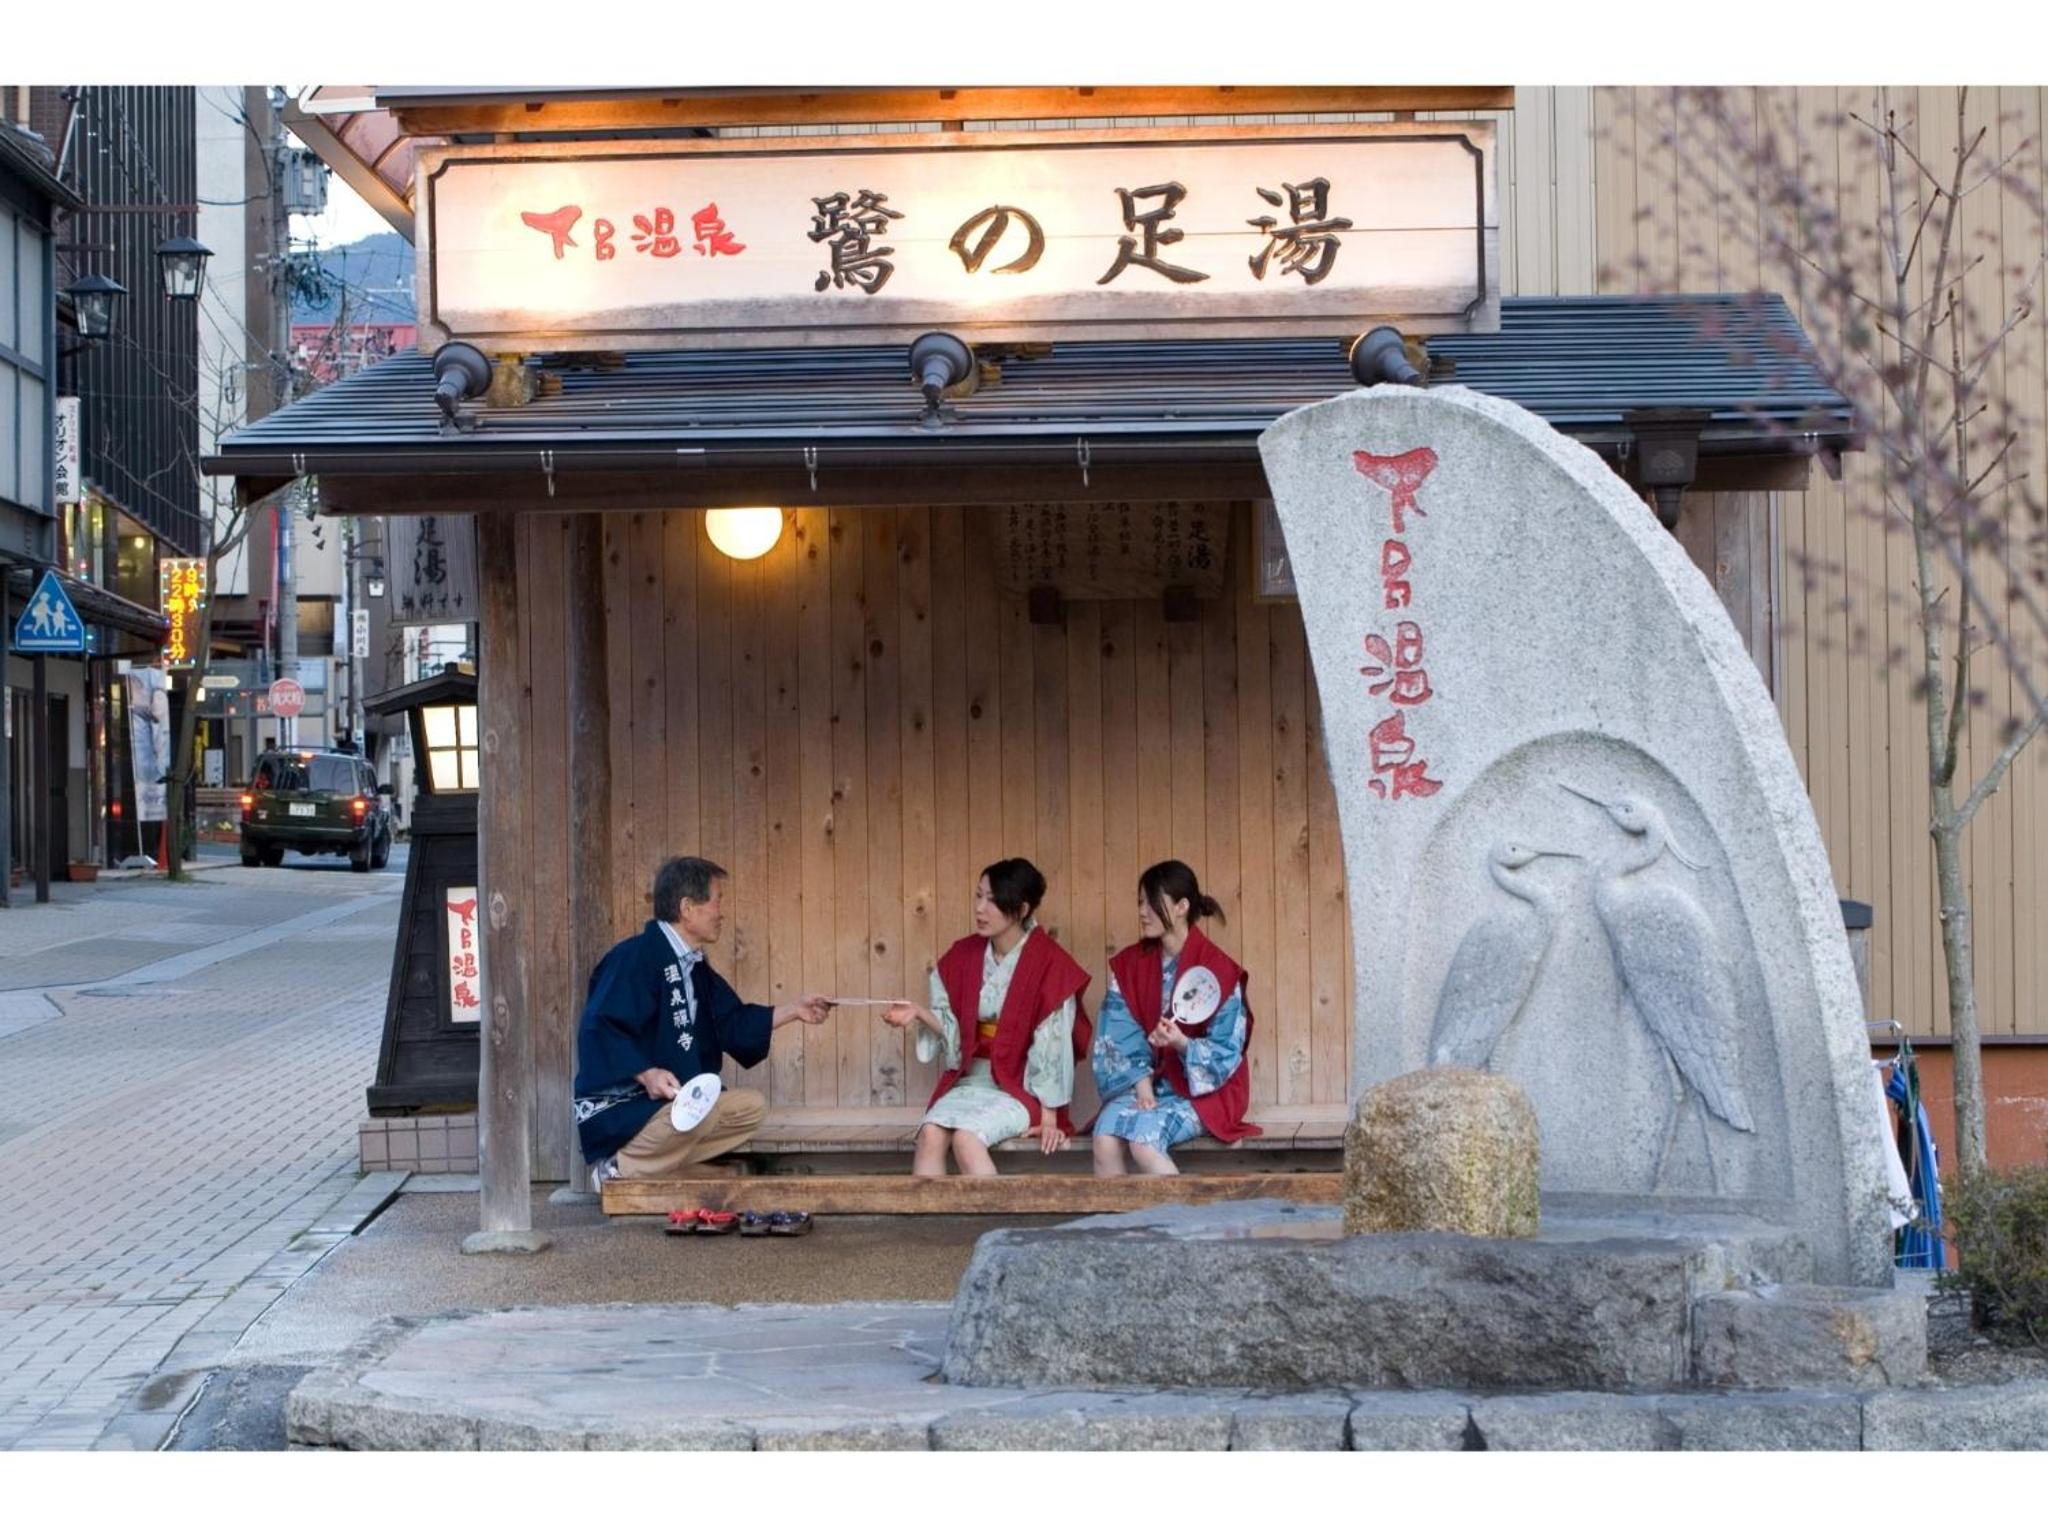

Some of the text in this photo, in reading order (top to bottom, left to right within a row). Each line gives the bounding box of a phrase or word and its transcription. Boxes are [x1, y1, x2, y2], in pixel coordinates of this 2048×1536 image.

[521, 176, 1354, 295] 下呂温泉 鷺の足湯
[414, 515, 447, 587] 足湯
[1352, 446, 1444, 801] 下呂温泉
[447, 898, 480, 1008] 下呂温泉
